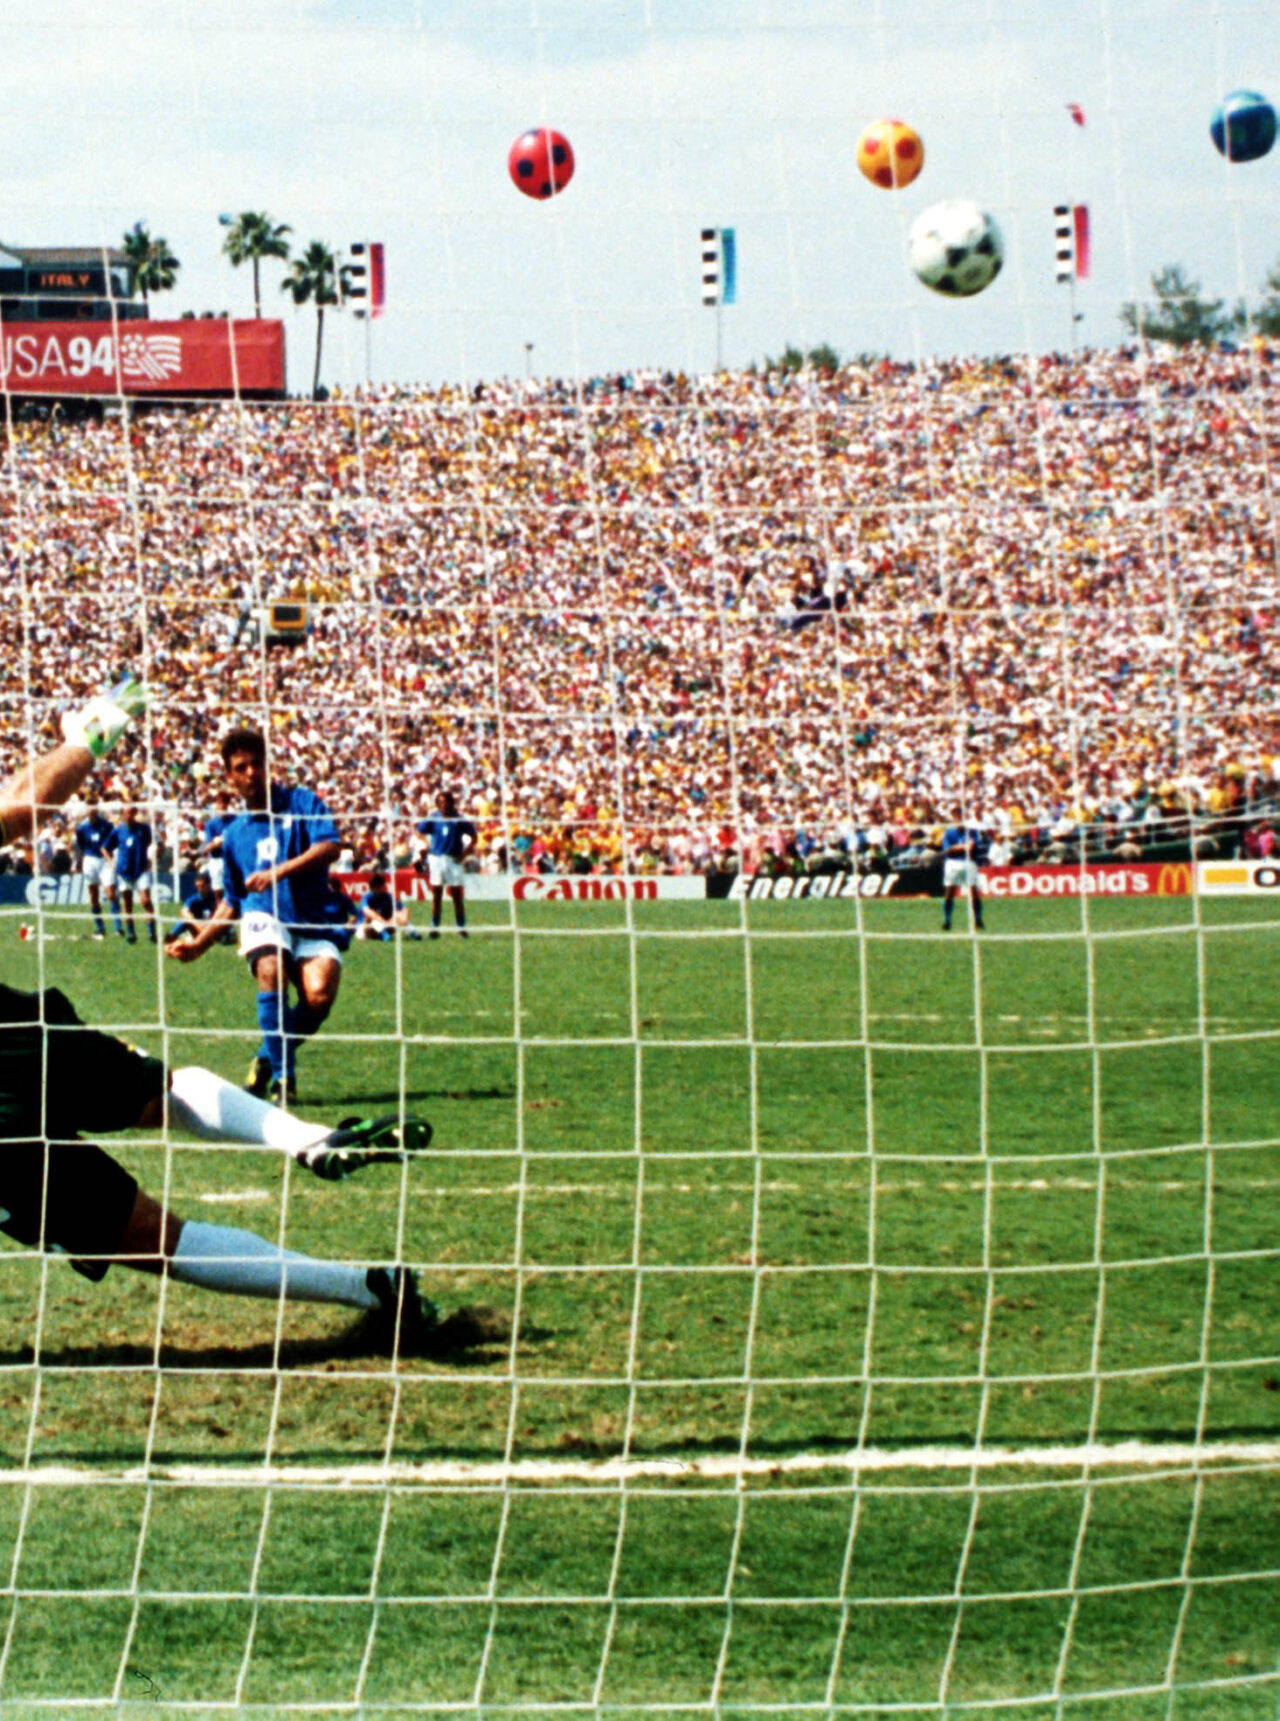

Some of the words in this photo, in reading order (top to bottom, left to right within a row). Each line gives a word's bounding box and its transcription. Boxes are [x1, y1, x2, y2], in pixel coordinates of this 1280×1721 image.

[41, 274, 90, 287] ITALY
[513, 876, 658, 900] Canon
[727, 870, 900, 899] Energizer
